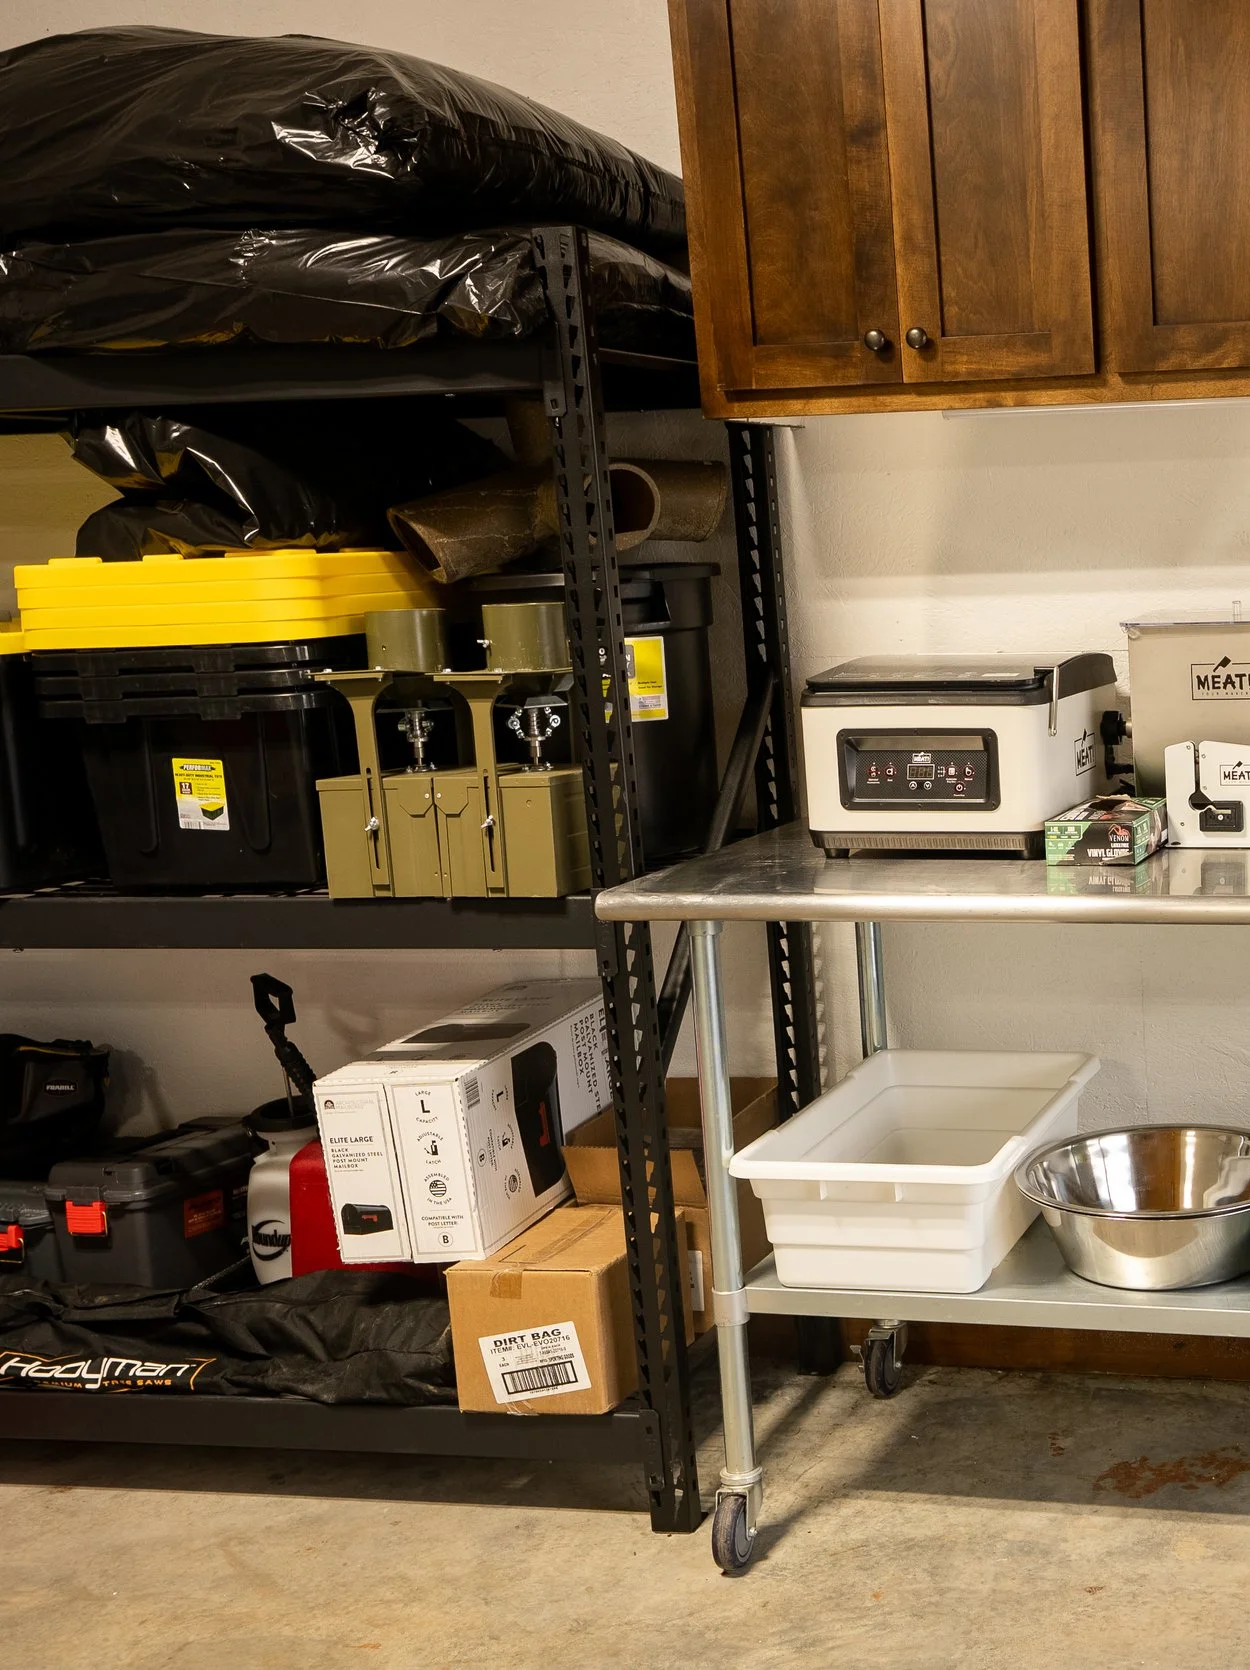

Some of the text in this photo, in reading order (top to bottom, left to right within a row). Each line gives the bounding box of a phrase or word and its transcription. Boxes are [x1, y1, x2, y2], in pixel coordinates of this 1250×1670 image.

[182, 782, 189, 790] 17
[1087, 849, 1105, 857] VINYL
[589, 1013, 598, 1049] BLACK
[573, 1022, 584, 1075] MAILBOX
[584, 1016, 597, 1087] GALVANIZED
[579, 1020, 593, 1094] POST MOUNT
[420, 1100, 430, 1113] L
[416, 1131, 443, 1141] ADJUSTABLE
[424, 1173, 449, 1182] ASSEMBLED
[443, 1235, 449, 1243] B
[493, 1335, 526, 1348] DIRT
[531, 1328, 561, 1342] BAG
[516, 1335, 570, 1350] EVL-EVO20716
